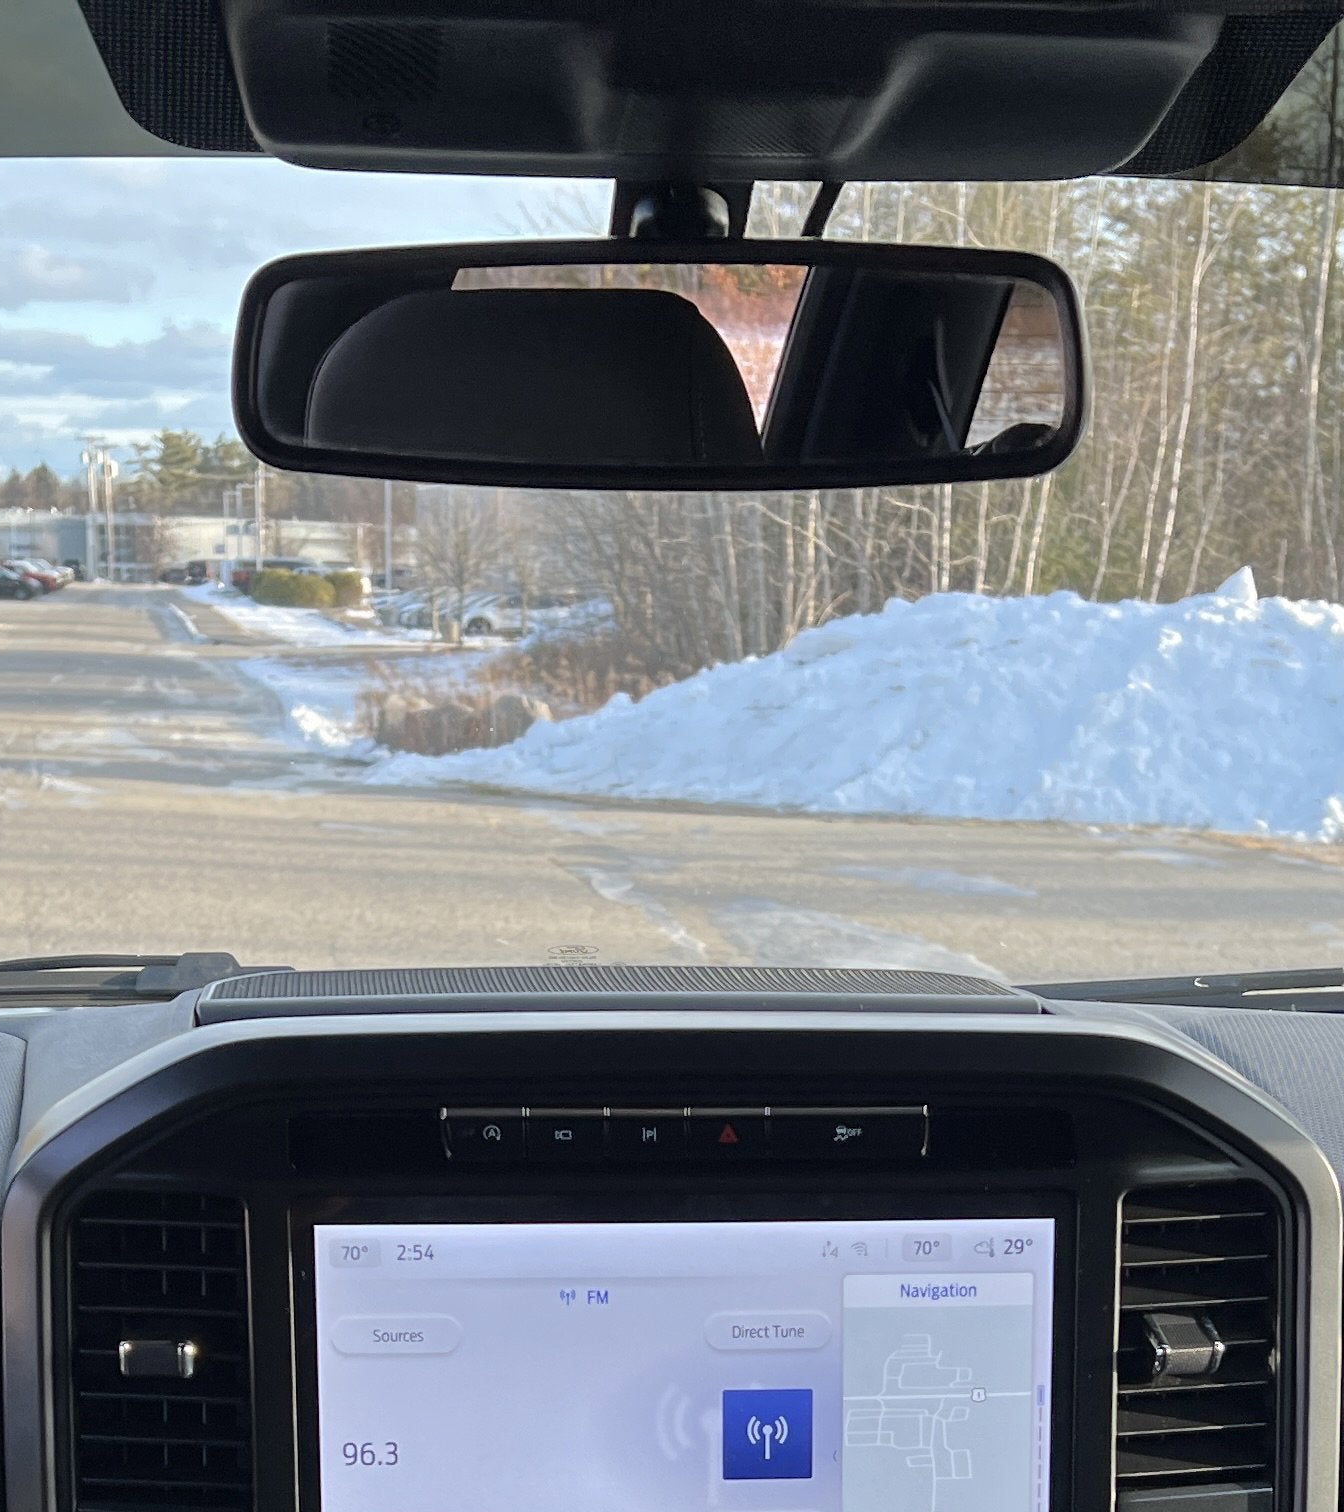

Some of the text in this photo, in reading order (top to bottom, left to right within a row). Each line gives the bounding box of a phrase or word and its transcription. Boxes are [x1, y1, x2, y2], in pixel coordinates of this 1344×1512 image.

[847, 1127, 863, 1137] OFF
[341, 1245, 369, 1261] 70°
[396, 1244, 435, 1261] 2:54
[914, 1240, 940, 1256] 70°
[1003, 1238, 1033, 1255] 29°
[587, 1290, 610, 1305] FM
[900, 1283, 978, 1301] Navigation
[373, 1328, 424, 1343] Sources
[731, 1325, 805, 1339] Direct Tune
[342, 1441, 399, 1466] 96.3
